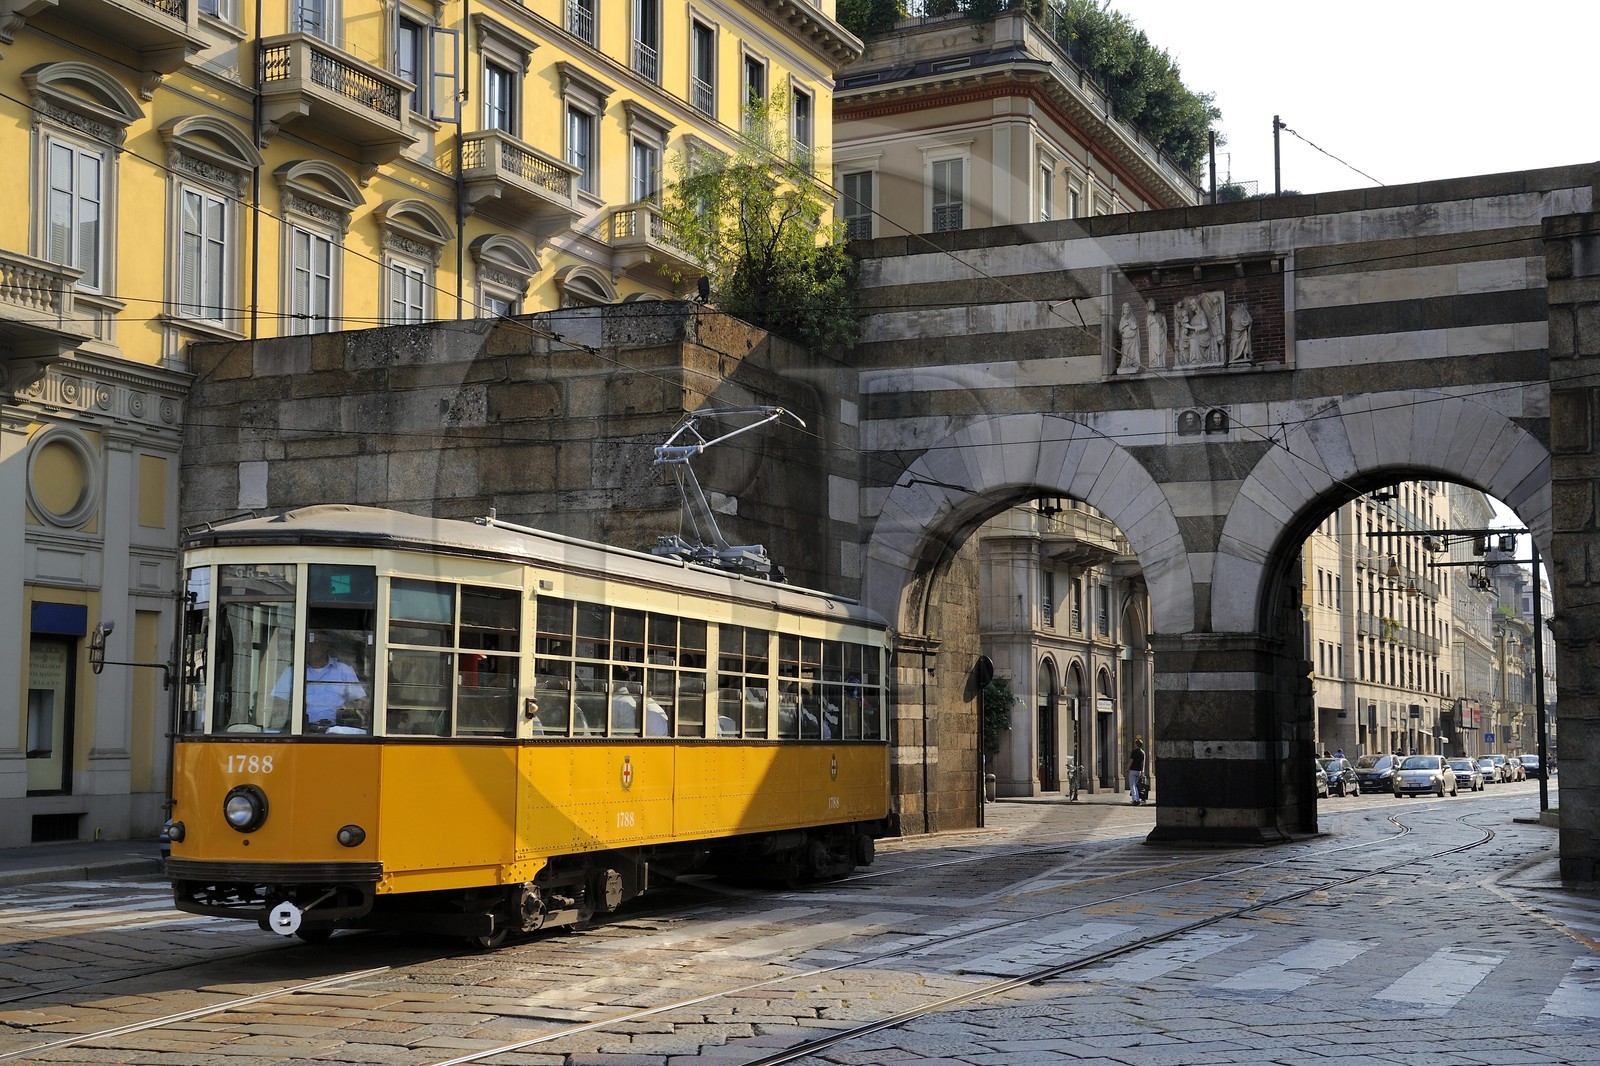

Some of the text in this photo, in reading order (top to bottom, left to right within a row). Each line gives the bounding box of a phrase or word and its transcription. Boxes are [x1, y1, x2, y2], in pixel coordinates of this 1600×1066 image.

[227, 755, 273, 774] 1788
[828, 796, 840, 809] 1788
[616, 811, 635, 828] 1788
